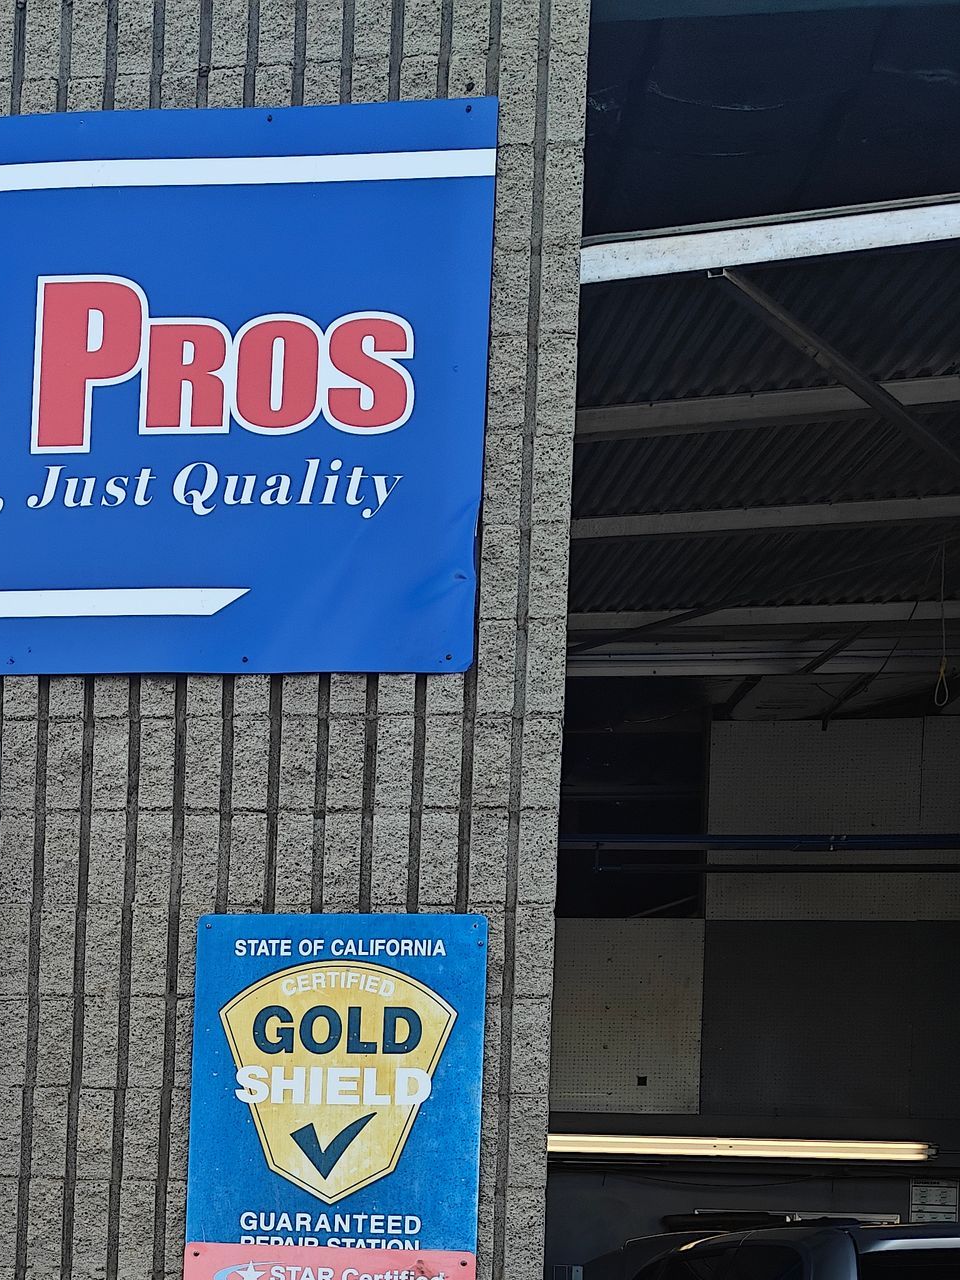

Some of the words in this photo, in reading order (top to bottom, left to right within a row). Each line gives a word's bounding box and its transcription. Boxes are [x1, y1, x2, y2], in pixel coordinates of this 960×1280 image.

[30, 274, 415, 455] PROS
[26, 464, 157, 509] Just
[171, 457, 404, 519] Quality
[234, 939, 292, 957] STATE
[298, 939, 323, 957] OF
[330, 939, 447, 957] CALIFORNIA
[280, 971, 396, 998] CERTIFIED
[252, 1005, 423, 1055] GOLD
[234, 1065, 432, 1105] SHIELD
[239, 1211, 422, 1235] GUARANTEED
